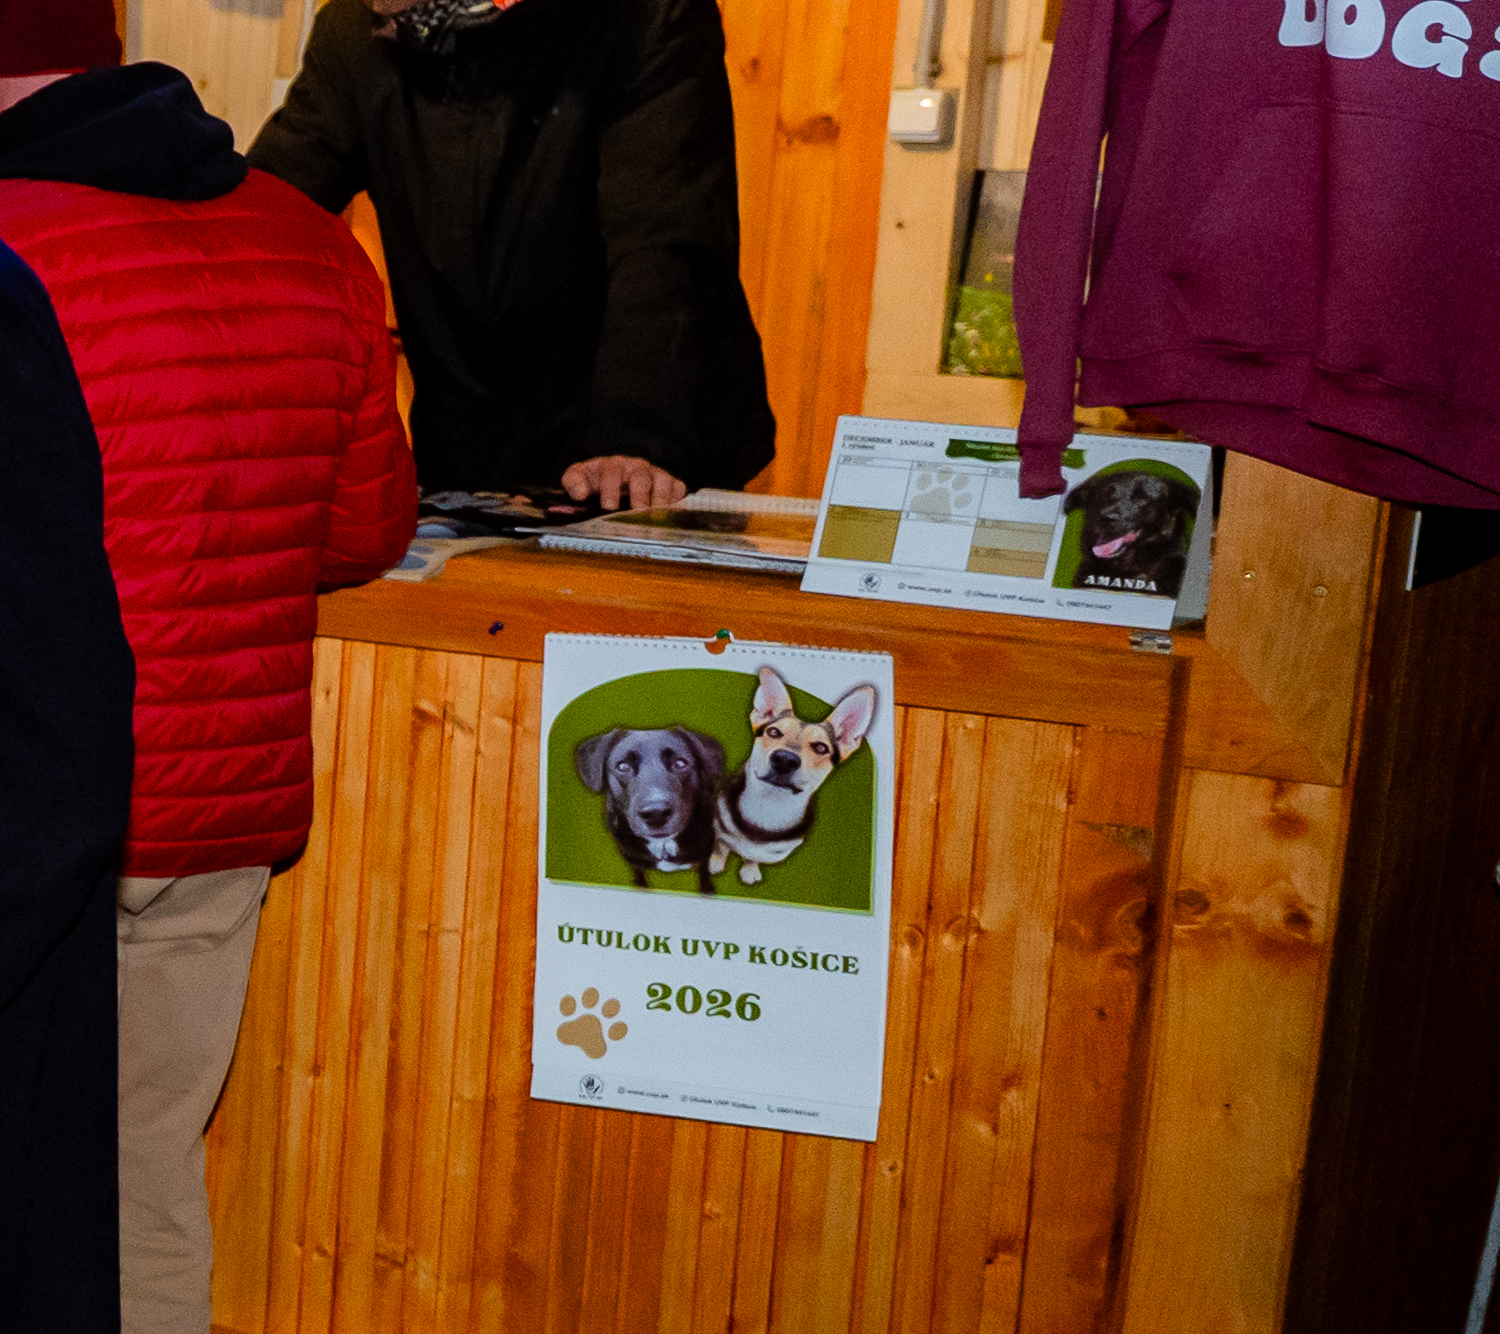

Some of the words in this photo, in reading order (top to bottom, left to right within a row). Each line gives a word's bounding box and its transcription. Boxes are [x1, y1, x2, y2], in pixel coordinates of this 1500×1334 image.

[1084, 573, 1157, 592] AMANDA
[556, 922, 672, 955] ÚTULOK
[680, 937, 740, 960] UVP
[748, 943, 860, 976] KOŠICE
[646, 982, 762, 1022] 2026
